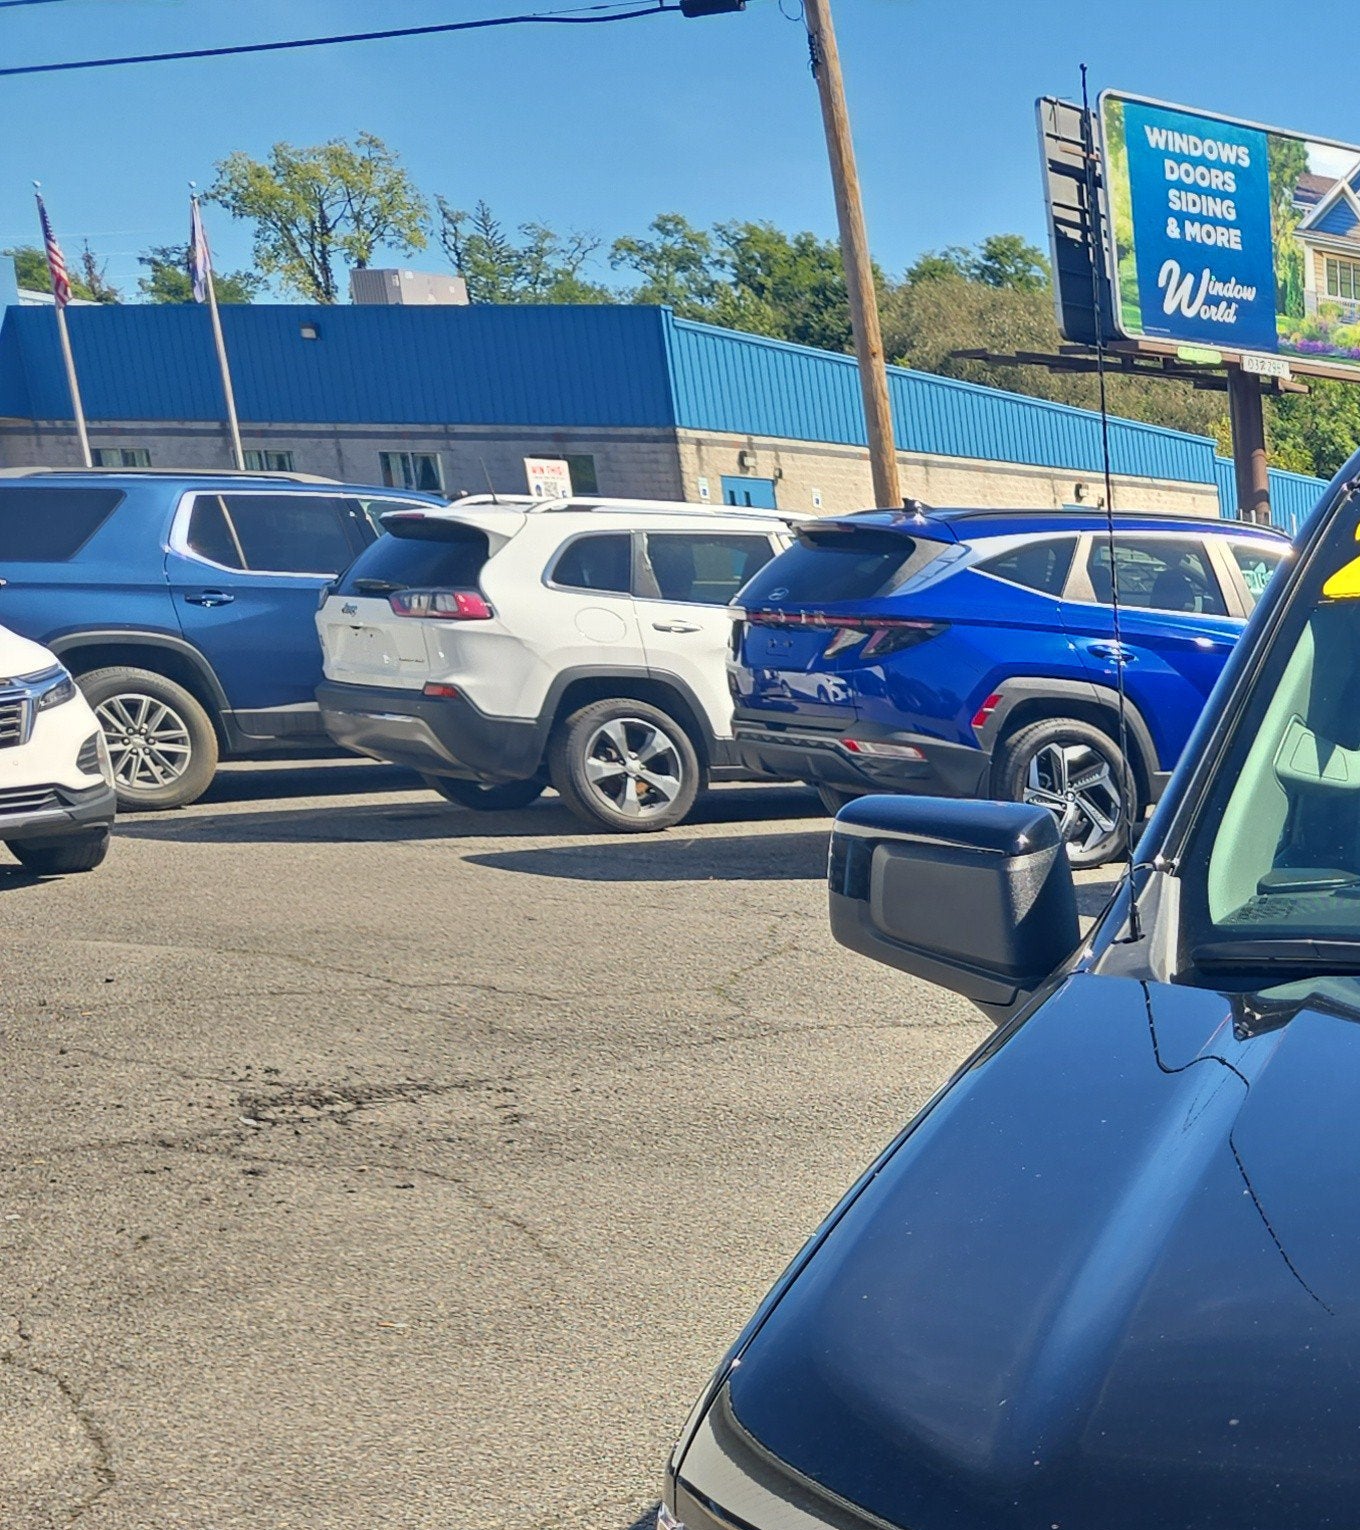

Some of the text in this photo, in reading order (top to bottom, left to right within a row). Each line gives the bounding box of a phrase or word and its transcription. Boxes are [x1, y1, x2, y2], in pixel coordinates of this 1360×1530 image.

[1144, 125, 1250, 168] WINDOWS
[1164, 159, 1237, 193] DOORS
[1168, 188, 1237, 221] SIDING
[1166, 217, 1242, 250] & MORE
[1158, 259, 1256, 318] Window
